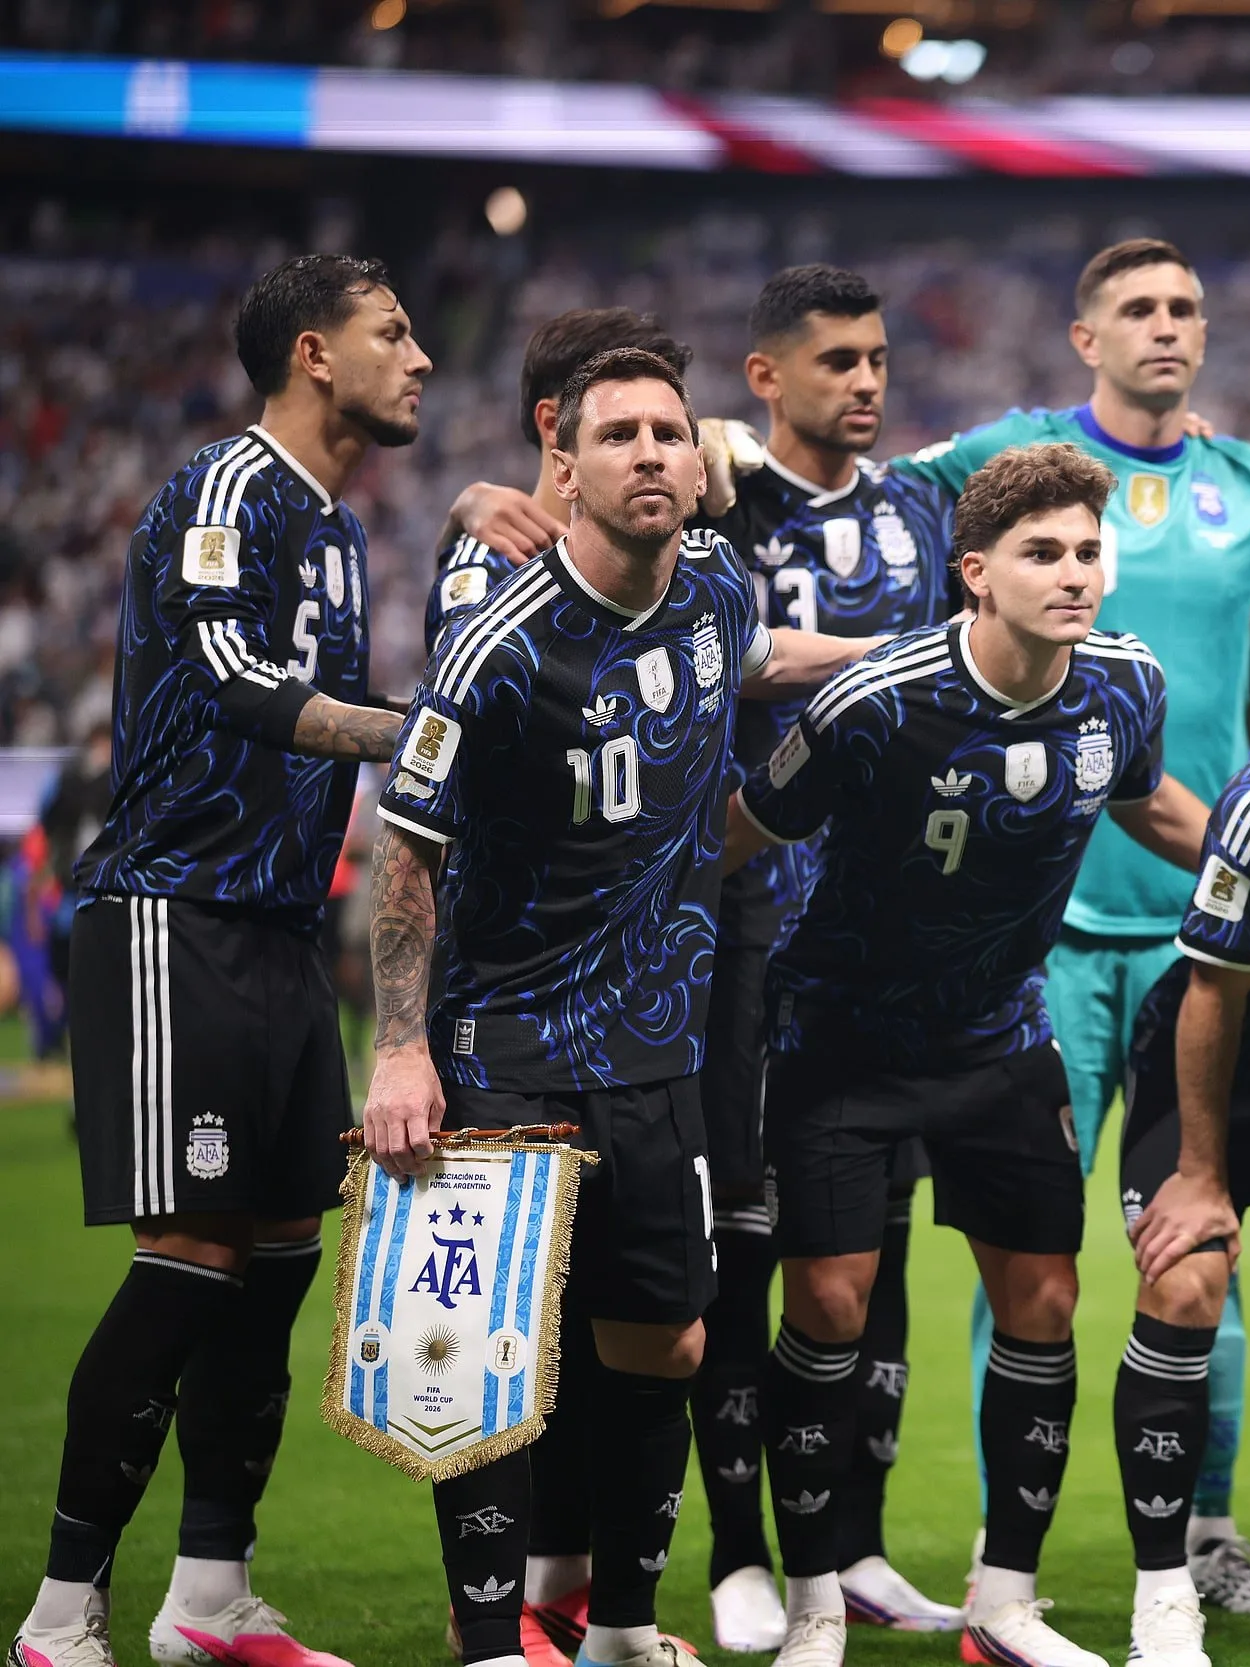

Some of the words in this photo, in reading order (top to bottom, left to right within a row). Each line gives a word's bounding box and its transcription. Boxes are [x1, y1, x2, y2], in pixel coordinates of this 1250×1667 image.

[287, 600, 320, 684] 5
[700, 645, 718, 670] AFA
[652, 687, 667, 699] FIFA
[410, 759, 434, 774] 2026
[1084, 750, 1106, 774] AFA
[567, 735, 641, 825] 10
[1017, 780, 1036, 788] FIFA
[924, 809, 969, 876] 9
[196, 1142, 221, 1164] AFA
[430, 1180, 452, 1189] FÚTBOL
[453, 1182, 492, 1190] ARGENTINO
[435, 1172, 473, 1180] ASOCIACIÓN
[408, 1231, 482, 1309] AFA
[1134, 1427, 1186, 1463] AFA
